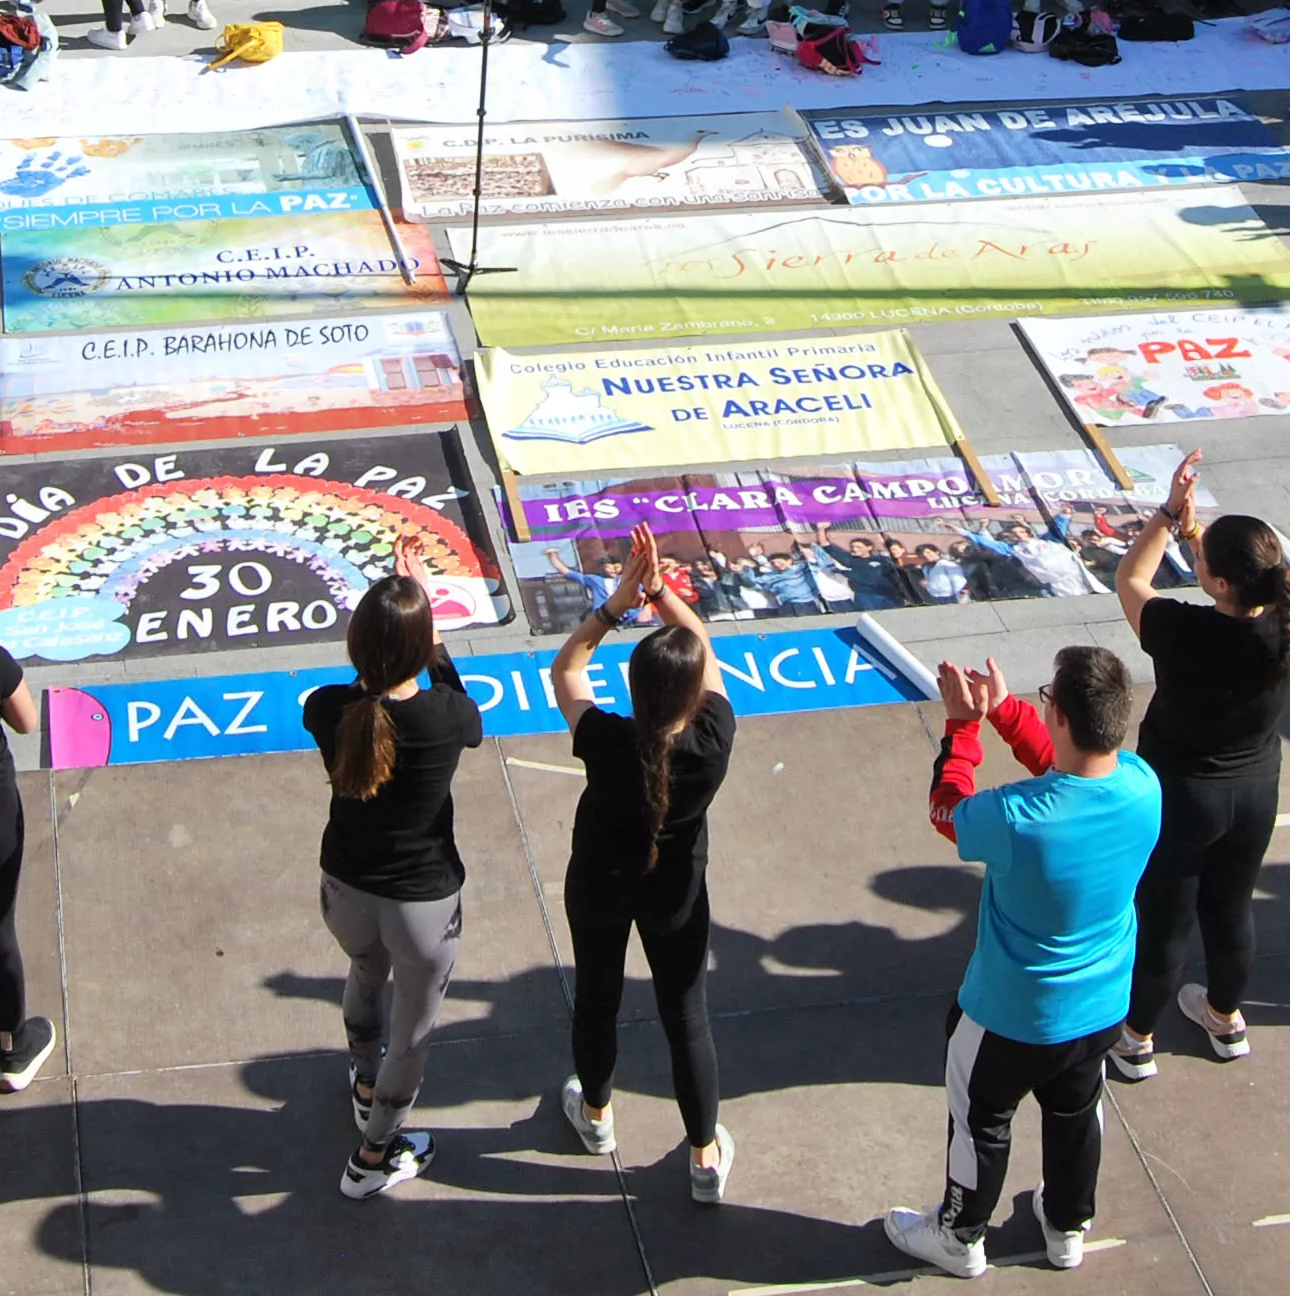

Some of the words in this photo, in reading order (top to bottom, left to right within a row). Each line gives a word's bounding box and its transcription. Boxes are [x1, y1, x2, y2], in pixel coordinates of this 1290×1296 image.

[882, 112, 992, 136] JUAN
[1007, 108, 1058, 130] DE
[1069, 99, 1250, 127] ARÉJULA
[510, 135, 537, 146] LA
[844, 184, 913, 202] POR
[921, 177, 969, 198] LA
[976, 167, 1133, 195] CULTURA
[1142, 165, 1170, 185] Y
[1175, 161, 1224, 181] LA
[65, 192, 98, 205] DE
[152, 202, 222, 221] POR
[232, 200, 272, 215] LA
[422, 204, 453, 218] La
[458, 202, 506, 216] Paz
[510, 197, 632, 213] comienza
[634, 193, 680, 208] con
[682, 191, 729, 206] una
[729, 187, 820, 203] sonrisa
[216, 245, 315, 264] C.E.I.P.
[714, 247, 908, 279] Sierra
[914, 241, 959, 261] de
[972, 238, 1098, 263] Aras
[116, 268, 255, 291] ANTONIO
[266, 257, 420, 279] MACHADO
[871, 305, 952, 320] LUCENA
[1191, 313, 1248, 325] CEIP
[1254, 317, 1276, 328] EL
[81, 336, 155, 361] C.E.I.P.
[164, 332, 278, 357] BARAHONA
[285, 328, 314, 347] DE
[320, 323, 370, 345] SOTO
[1138, 337, 1252, 364] PAZ
[510, 360, 587, 377] Colegio
[594, 353, 697, 371] Educación
[706, 348, 781, 364] Infantil
[788, 342, 877, 358] Primaria
[602, 371, 759, 396] NUESTRA
[769, 361, 915, 386] SEÑORA
[671, 407, 709, 423] DE
[722, 394, 872, 419] ARACELI
[723, 419, 770, 430] LUCENA
[114, 453, 185, 490] DE
[254, 447, 330, 475] LA
[353, 464, 465, 511] PAZ
[547, 497, 620, 523] IES
[178, 561, 273, 602] 30
[134, 598, 338, 643] ENERO
[127, 689, 270, 742] PAZ
